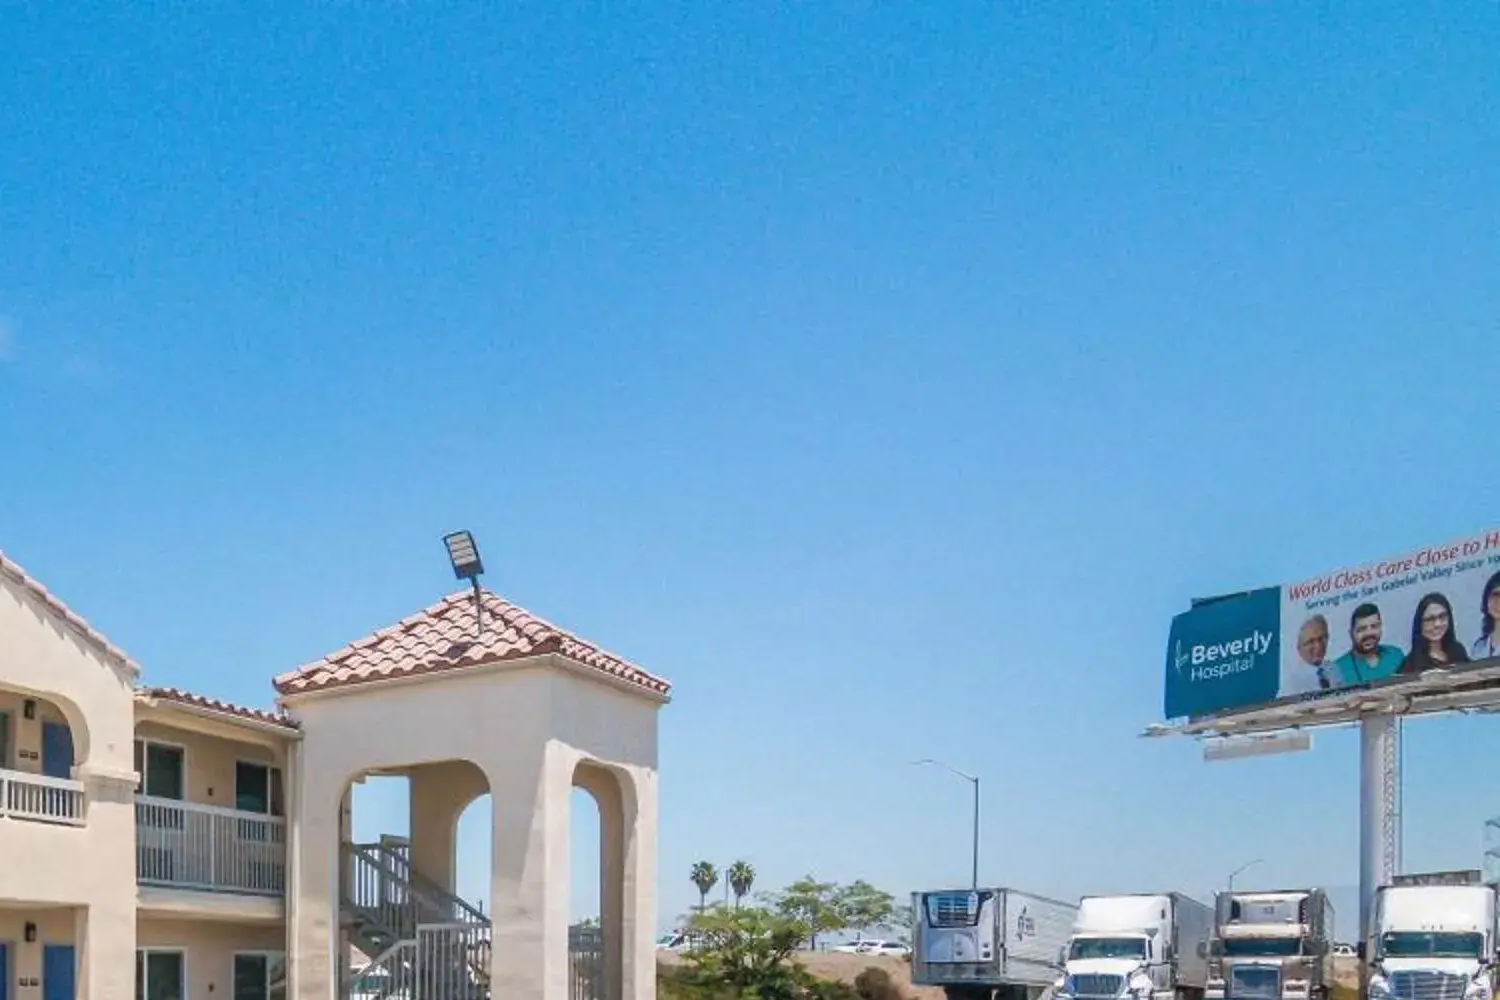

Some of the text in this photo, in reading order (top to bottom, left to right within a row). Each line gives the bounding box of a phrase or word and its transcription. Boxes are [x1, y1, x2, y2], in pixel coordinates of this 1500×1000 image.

[1289, 575, 1332, 601] World
[1334, 568, 1373, 590] Class
[1376, 559, 1413, 579] Care
[1415, 546, 1460, 567] Close
[1462, 540, 1481, 556] to
[1191, 629, 1273, 665] Beverly
[1191, 653, 1255, 682] Hospital
